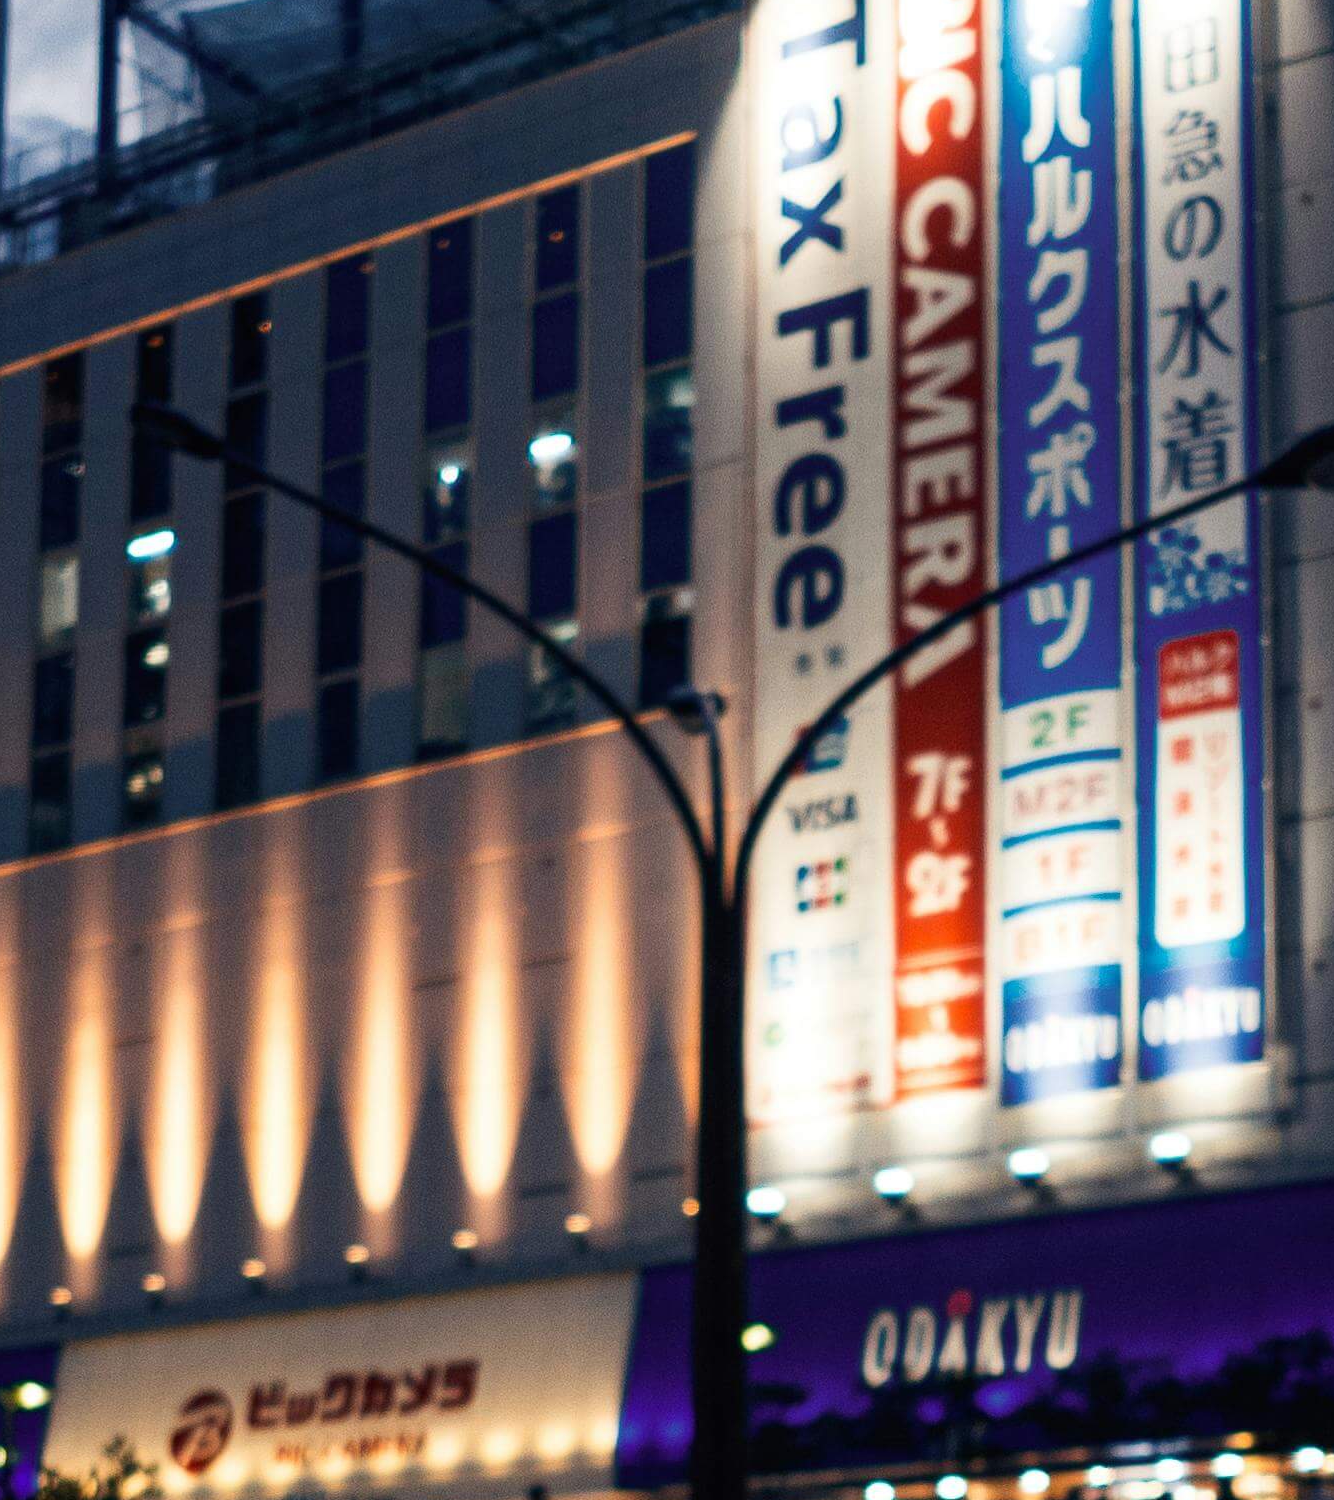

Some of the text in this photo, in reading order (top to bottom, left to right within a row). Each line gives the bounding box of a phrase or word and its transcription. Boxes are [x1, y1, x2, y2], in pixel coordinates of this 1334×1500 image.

[1021, 65, 1097, 670] ハルクスポーツ
[774, 287, 870, 630] Free
[900, 178, 978, 687] CAMERA
[1029, 702, 1093, 750] 2F
[784, 794, 859, 834] VISA
[907, 754, 971, 818] 7F
[1011, 774, 1110, 818] M2F
[862, 1290, 1083, 1389] ODAKYU
[247, 1357, 482, 1430] ビックカメラ
